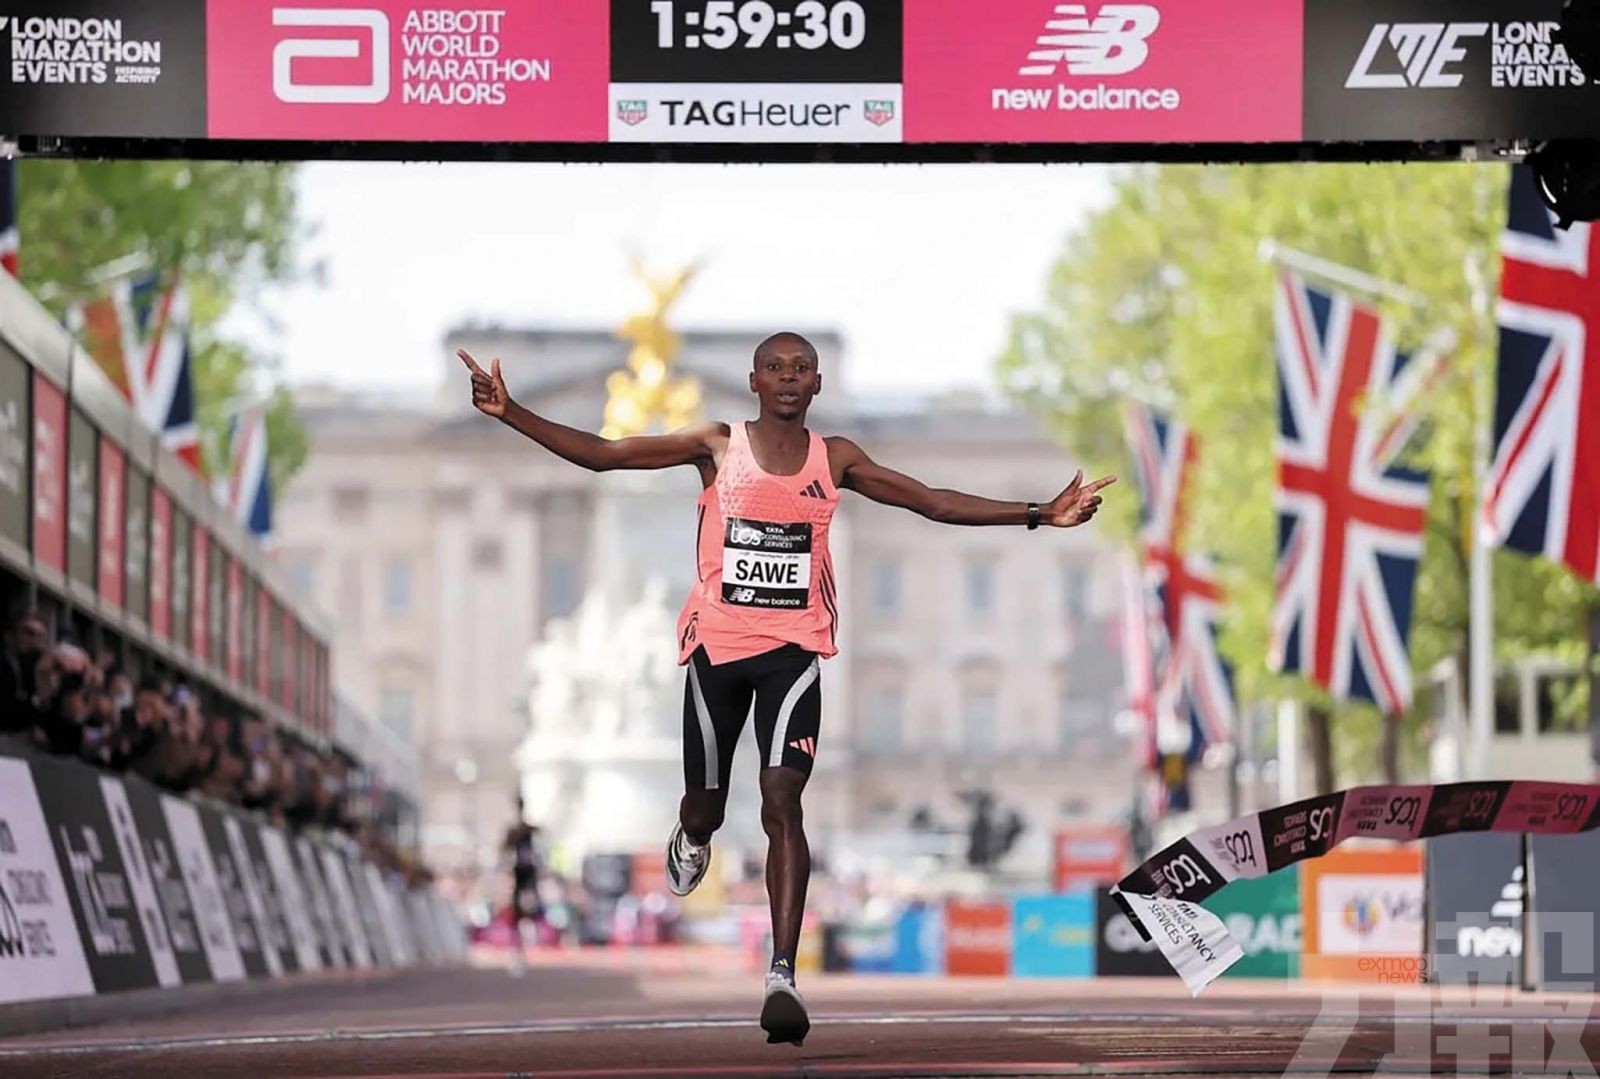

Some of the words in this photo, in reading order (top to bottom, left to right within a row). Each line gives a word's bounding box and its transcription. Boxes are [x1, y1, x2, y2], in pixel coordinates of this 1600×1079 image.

[11, 17, 122, 40] LONDON
[402, 10, 506, 33] ABBOTT
[651, 0, 866, 49] 1:59:30
[11, 39, 161, 63] MARATHON
[402, 34, 500, 57] WORLD
[12, 61, 107, 83] EVENTS
[402, 58, 550, 81] MARATHON
[1491, 65, 1585, 87] EVENTS
[402, 82, 506, 105] MAJORS
[991, 88, 1052, 110] new
[1057, 83, 1180, 110] balance
[735, 559, 799, 584] SAWE
[771, 598, 801, 606] balance
[1385, 796, 1422, 832] tcs
[1225, 829, 1258, 868] tcs
[1163, 853, 1212, 895] tcs
[1148, 902, 1184, 945] SERVICES
